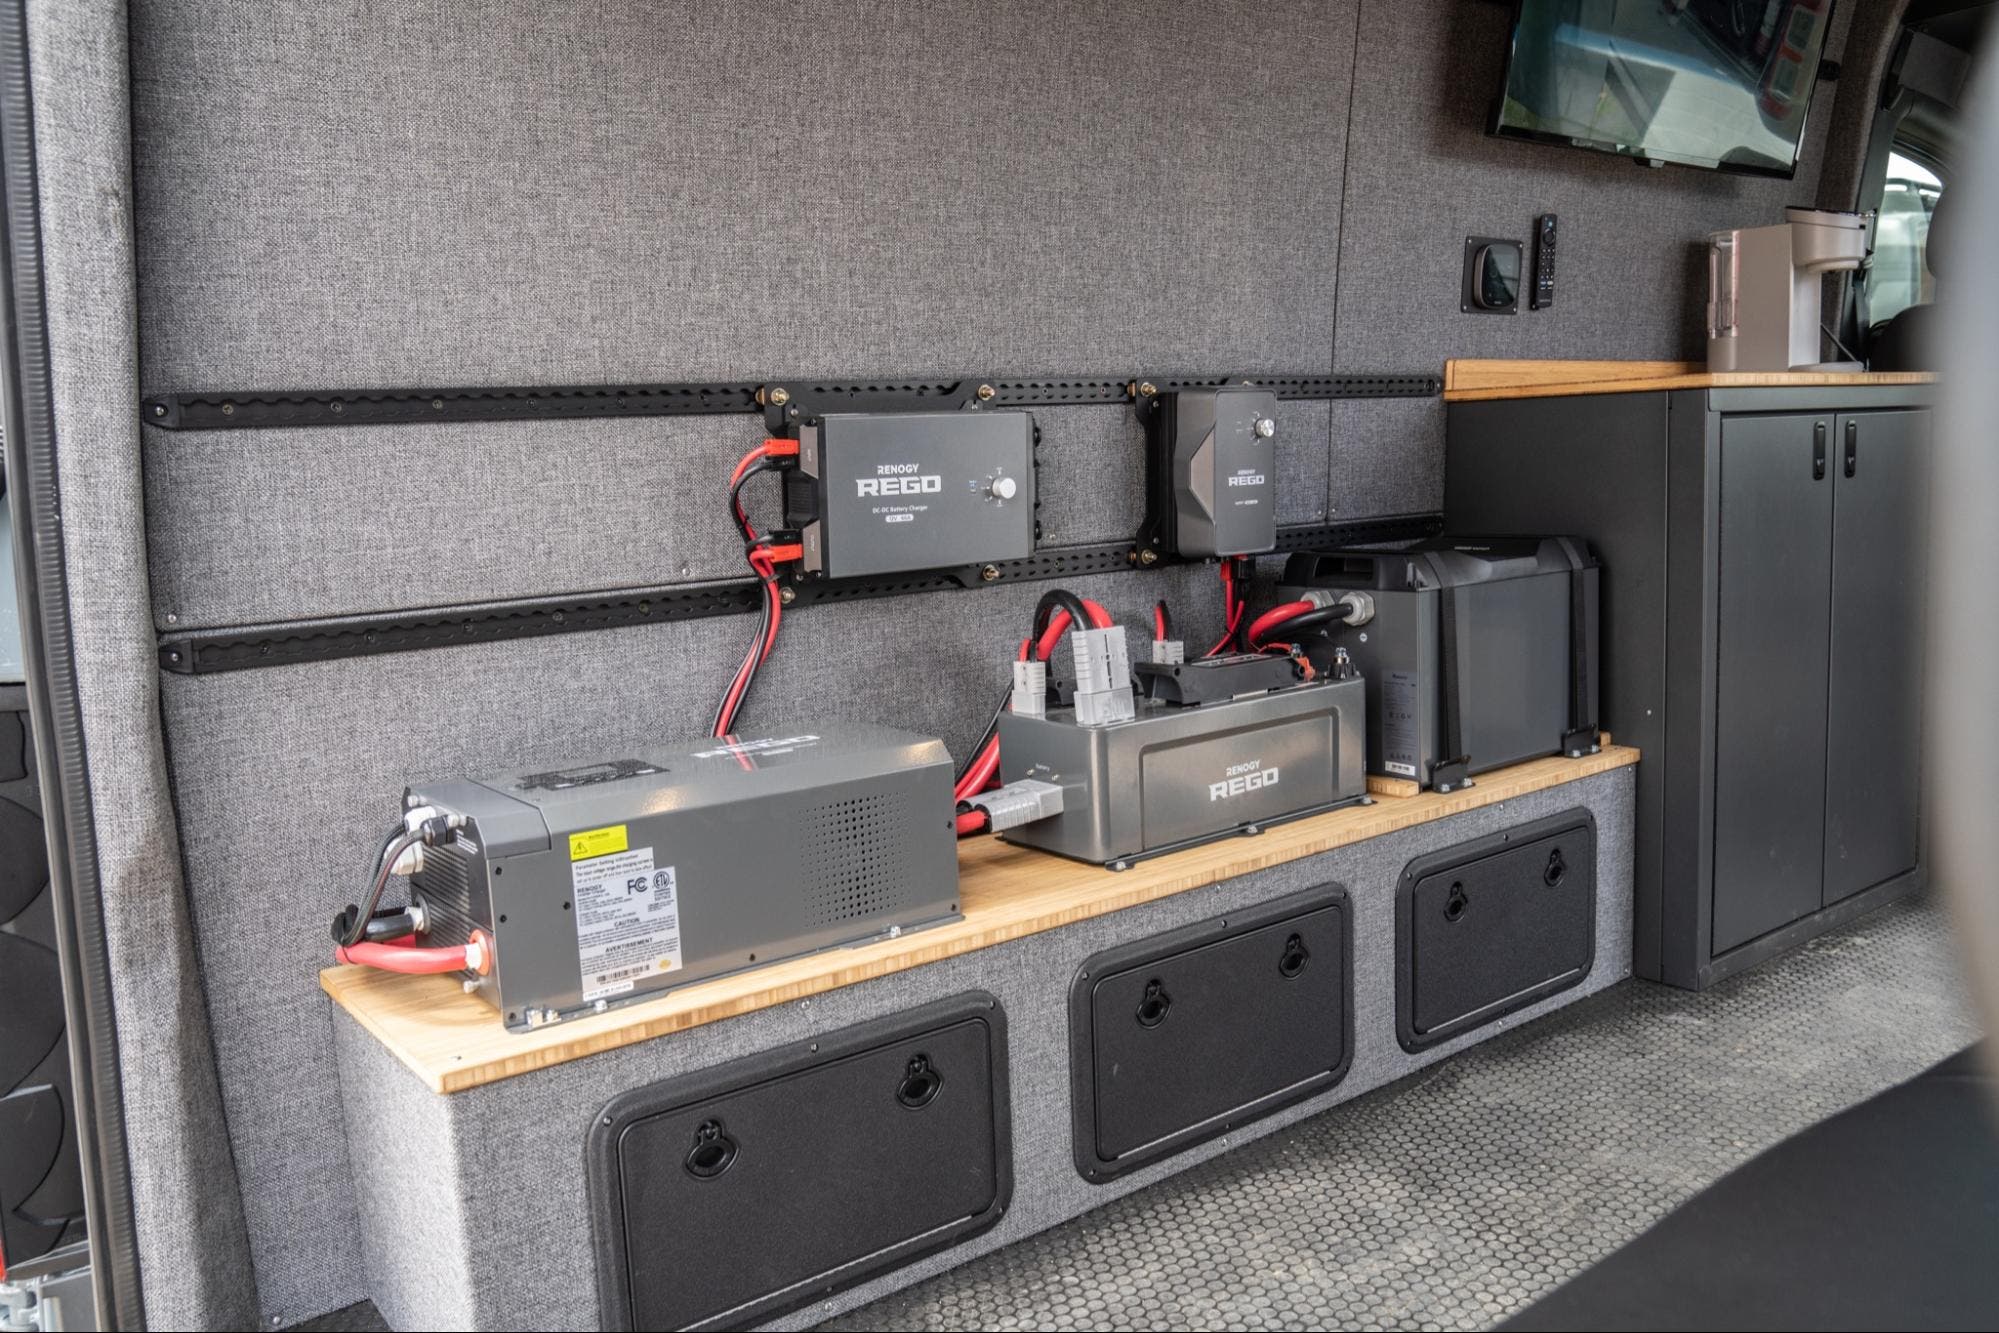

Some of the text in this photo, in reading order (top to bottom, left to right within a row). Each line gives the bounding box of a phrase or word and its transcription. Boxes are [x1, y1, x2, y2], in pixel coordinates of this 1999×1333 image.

[877, 463, 919, 475] RENOGY
[855, 475, 942, 497] REGO
[1228, 475, 1265, 487] REGO
[1226, 759, 1262, 777] RENOGY
[1208, 766, 1279, 801] REGO
[614, 917, 640, 927] CAUTION
[605, 937, 653, 953] AVERTISSEMENT
